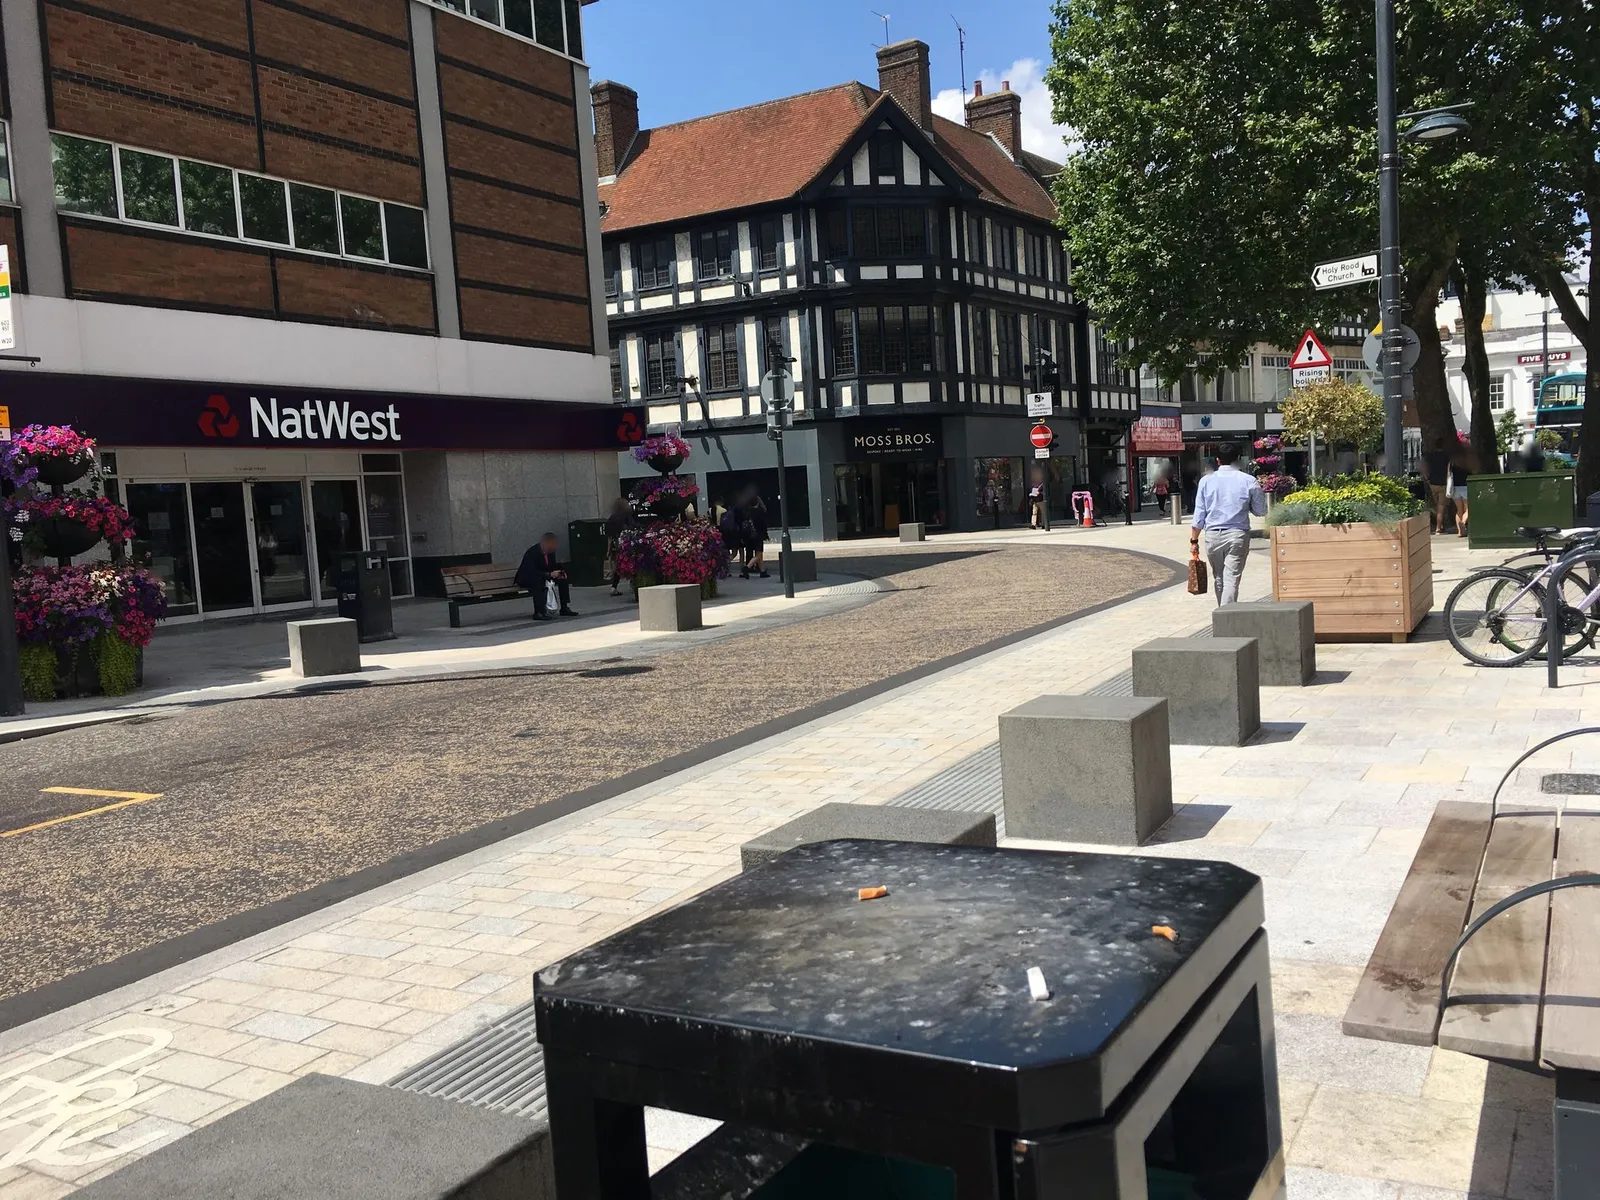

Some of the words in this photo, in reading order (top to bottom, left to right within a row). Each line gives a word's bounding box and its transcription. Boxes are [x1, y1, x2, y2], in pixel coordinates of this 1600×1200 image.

[1322, 266, 1338, 275] Holy
[1341, 261, 1359, 271] Rood
[1328, 272, 1354, 282] Church
[1546, 352, 1567, 360] UYS
[250, 396, 402, 441] NatWest
[854, 435, 892, 447] MOSS
[895, 433, 935, 445] BROS.
